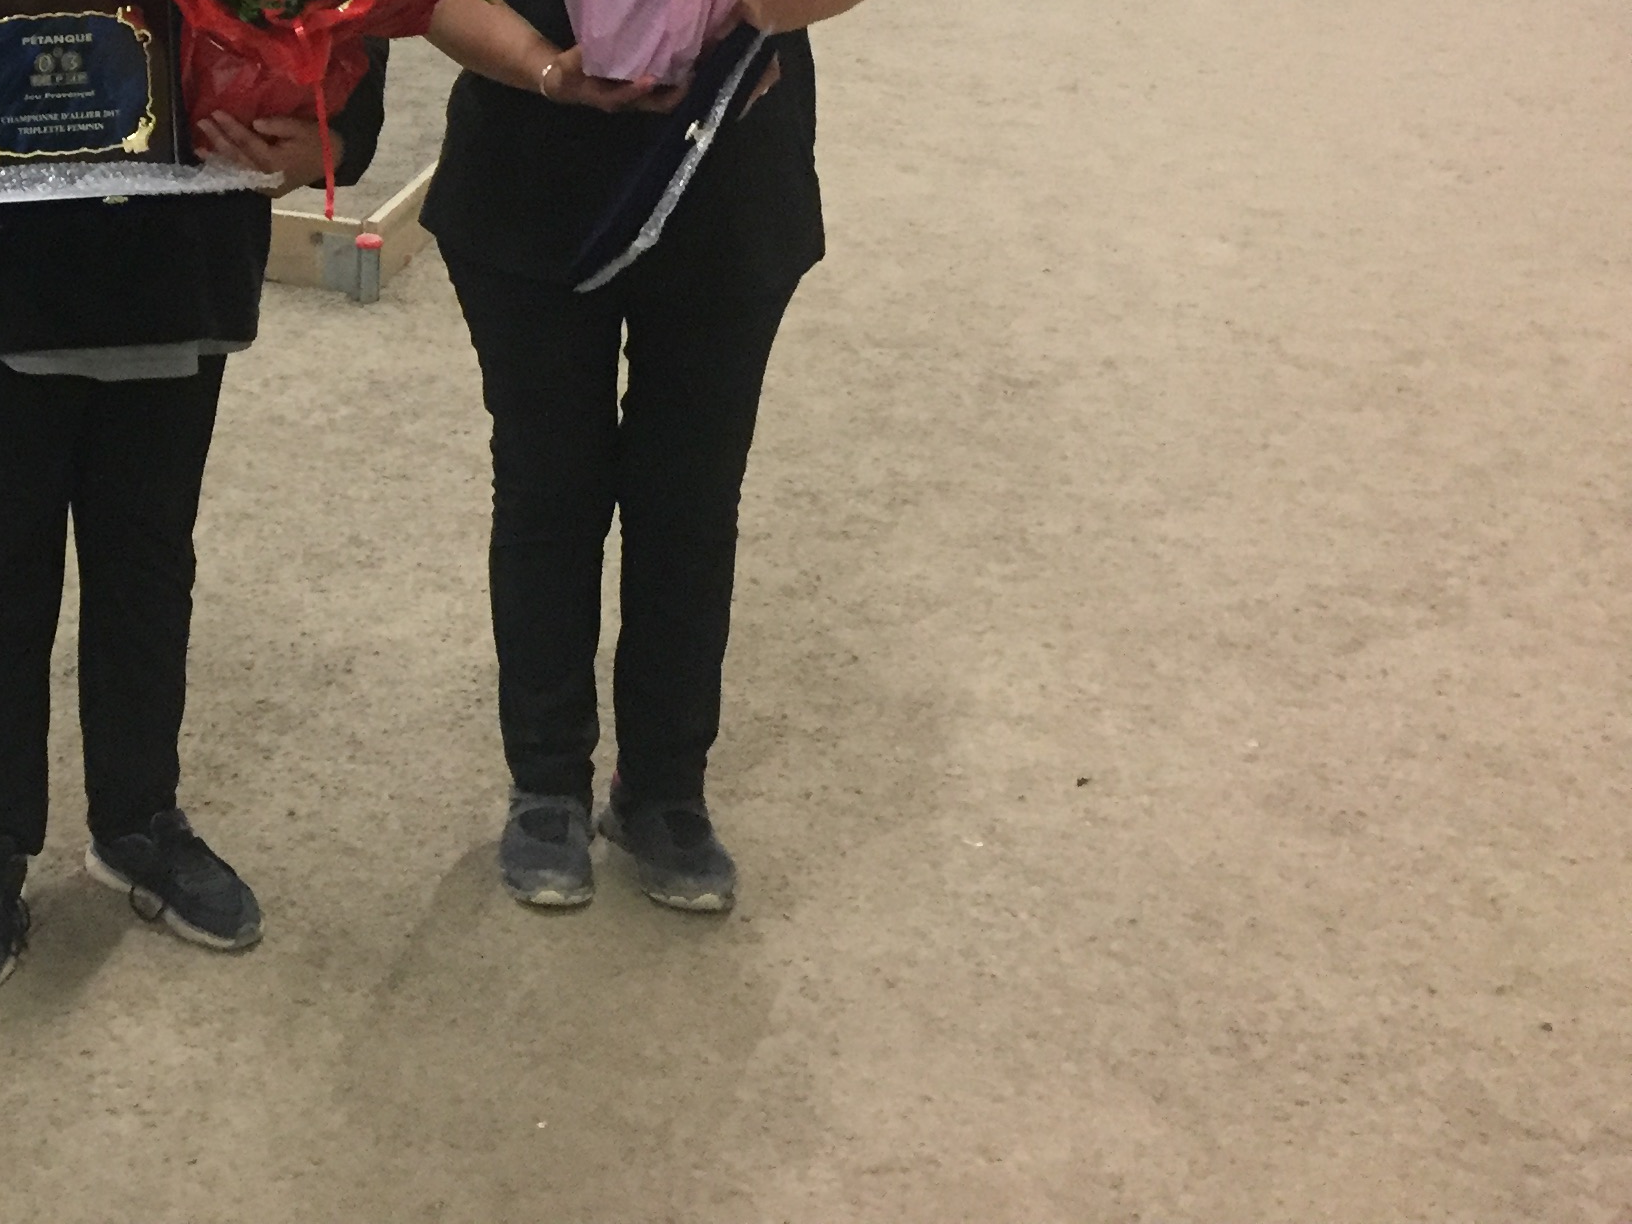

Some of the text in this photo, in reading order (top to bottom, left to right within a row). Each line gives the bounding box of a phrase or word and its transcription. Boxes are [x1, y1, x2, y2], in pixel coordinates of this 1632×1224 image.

[21, 32, 93, 46] PÉTANQUE
[0, 113, 59, 125] CHAMPIONNE
[60, 110, 101, 121] D'ALLIER
[18, 125, 66, 136] TRIPLETTE
